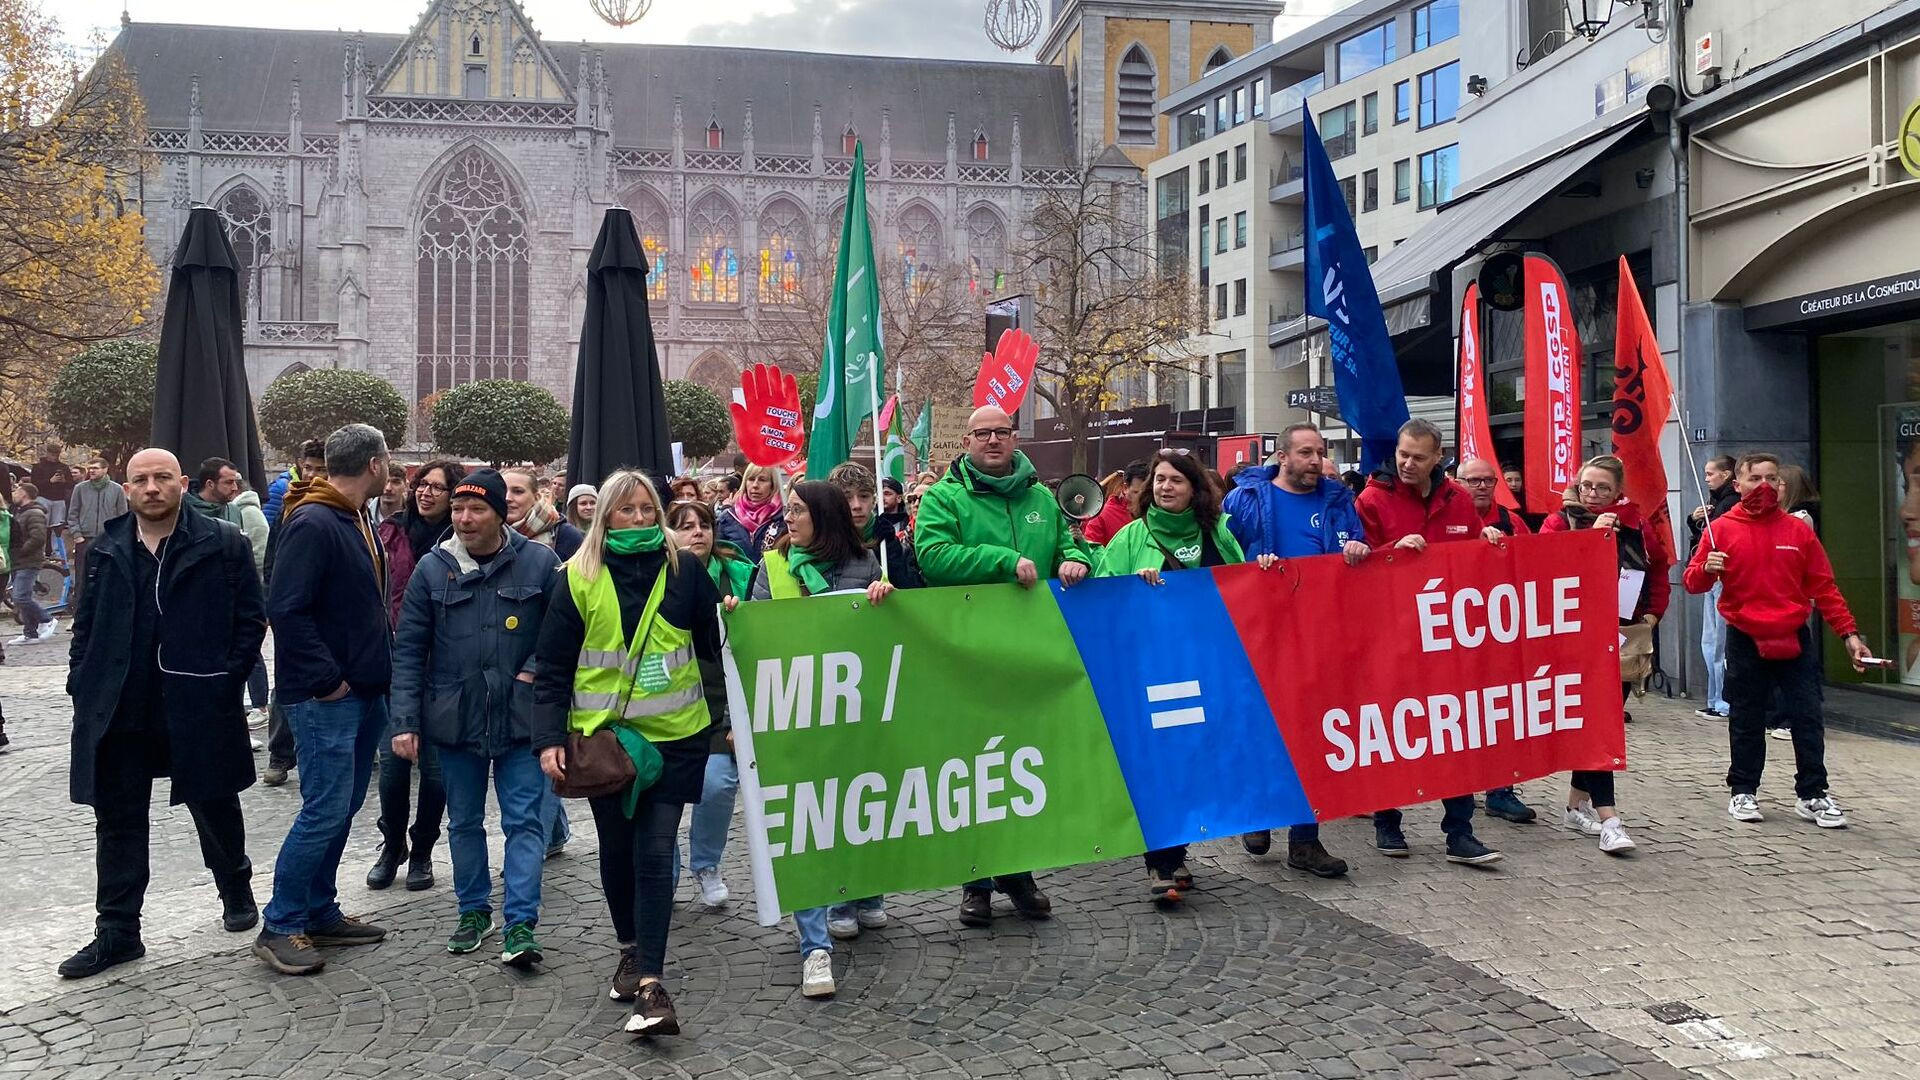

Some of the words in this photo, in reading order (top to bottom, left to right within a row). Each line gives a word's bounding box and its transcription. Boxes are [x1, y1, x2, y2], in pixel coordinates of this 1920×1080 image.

[1547, 293, 1563, 380] CGSP
[1800, 300, 1841, 314] CRÉATEUR
[1842, 294, 1853, 305] DE
[1855, 291, 1867, 303] LA
[767, 407, 797, 419] TOUCHE
[781, 419, 796, 427] PAS
[1416, 578, 1582, 653] ÉCOLE
[753, 651, 863, 733] MR
[1322, 664, 1584, 772] SACRIFIÉE
[760, 735, 1047, 859] ENGAGÉS
